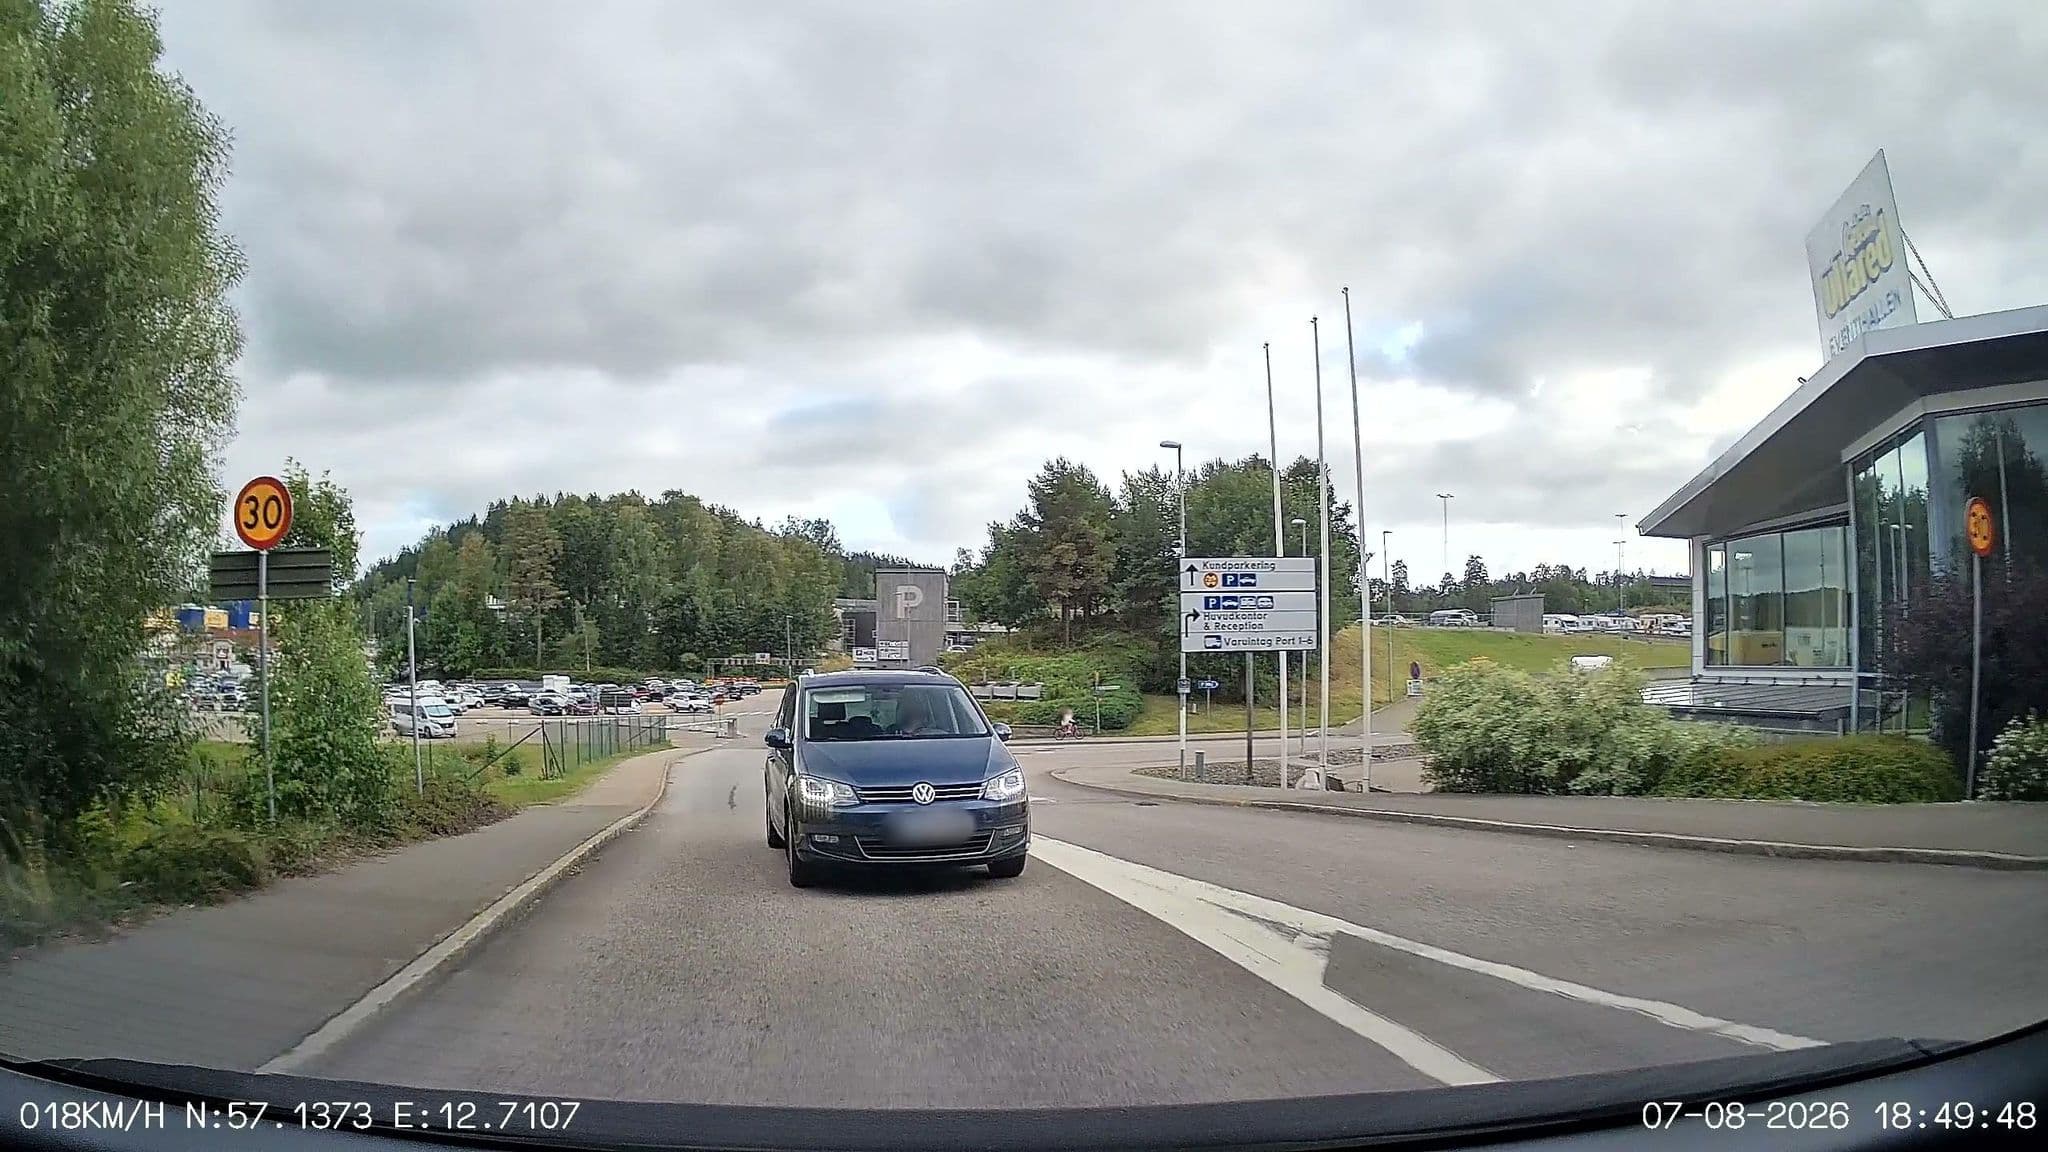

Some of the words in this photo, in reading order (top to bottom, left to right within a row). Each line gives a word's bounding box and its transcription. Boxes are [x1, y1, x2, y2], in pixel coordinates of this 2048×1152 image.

[243, 495, 282, 529] 30
[1202, 560, 1276, 571] Kundparkering
[1227, 575, 1235, 585] P
[896, 585, 923, 618] P
[1209, 598, 1217, 608] P
[1203, 612, 1268, 621] Huvudkontor
[1214, 622, 1264, 631] Reception
[1275, 637, 1295, 645] Port
